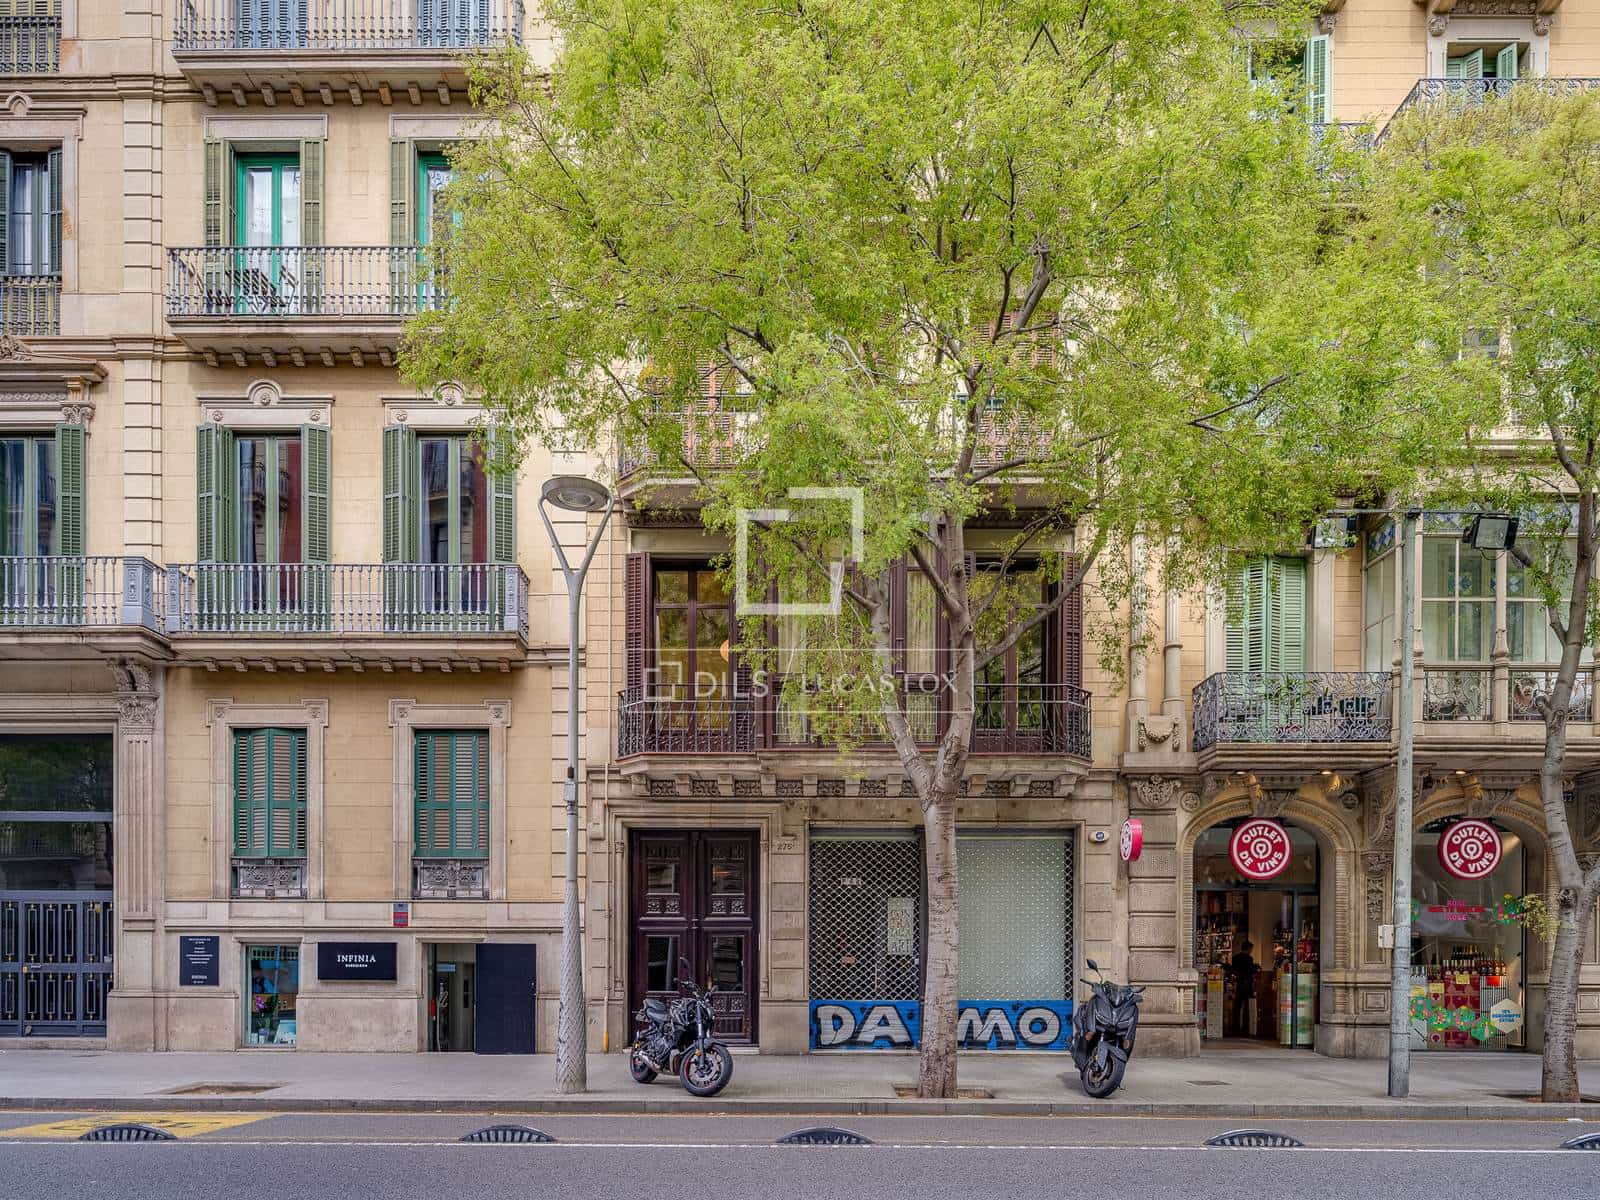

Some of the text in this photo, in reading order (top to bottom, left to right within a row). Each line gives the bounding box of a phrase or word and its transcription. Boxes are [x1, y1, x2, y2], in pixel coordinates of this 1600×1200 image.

[1242, 826, 1282, 843] OUTLET
[1452, 826, 1493, 844] OUTLET
[1239, 851, 1283, 871] DE VINS
[1449, 851, 1494, 873] DE VINS
[337, 954, 376, 963] INFINIA
